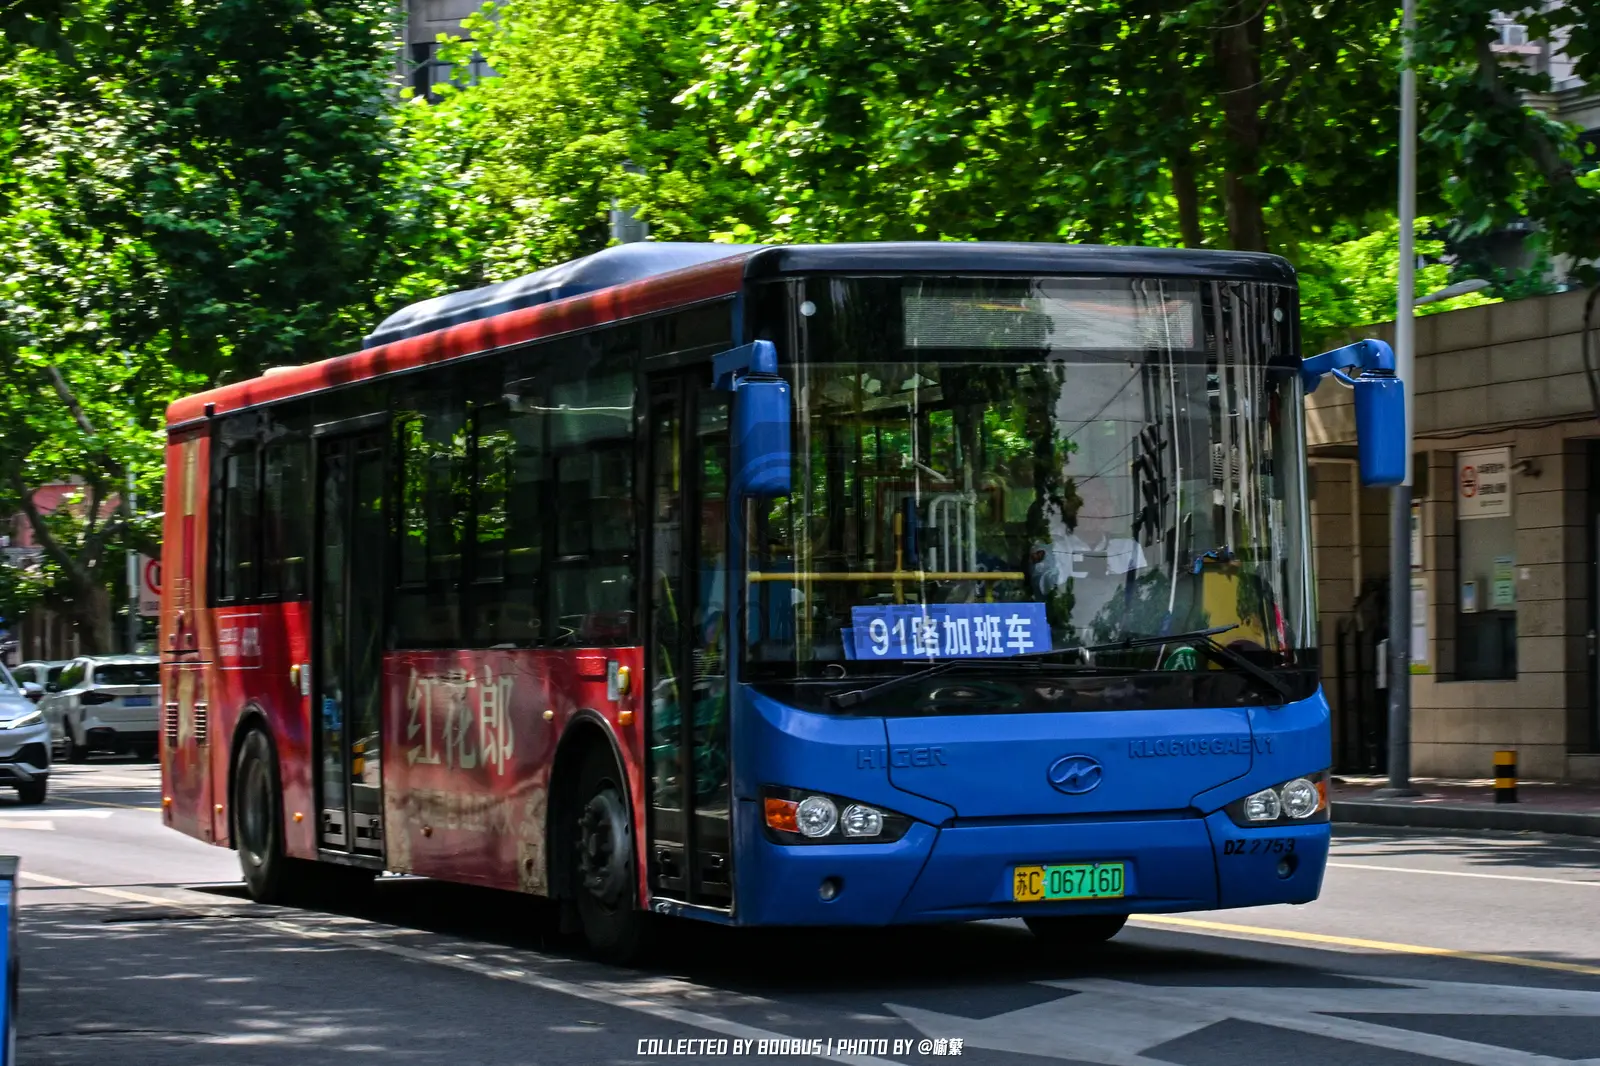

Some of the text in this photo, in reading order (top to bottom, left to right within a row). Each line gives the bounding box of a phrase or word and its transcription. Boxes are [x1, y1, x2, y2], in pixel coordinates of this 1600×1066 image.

[869, 614, 1034, 657] 91路加班车
[407, 664, 514, 776] 红花郎
[857, 746, 948, 769] HIGER
[1249, 838, 1296, 855] 2753
